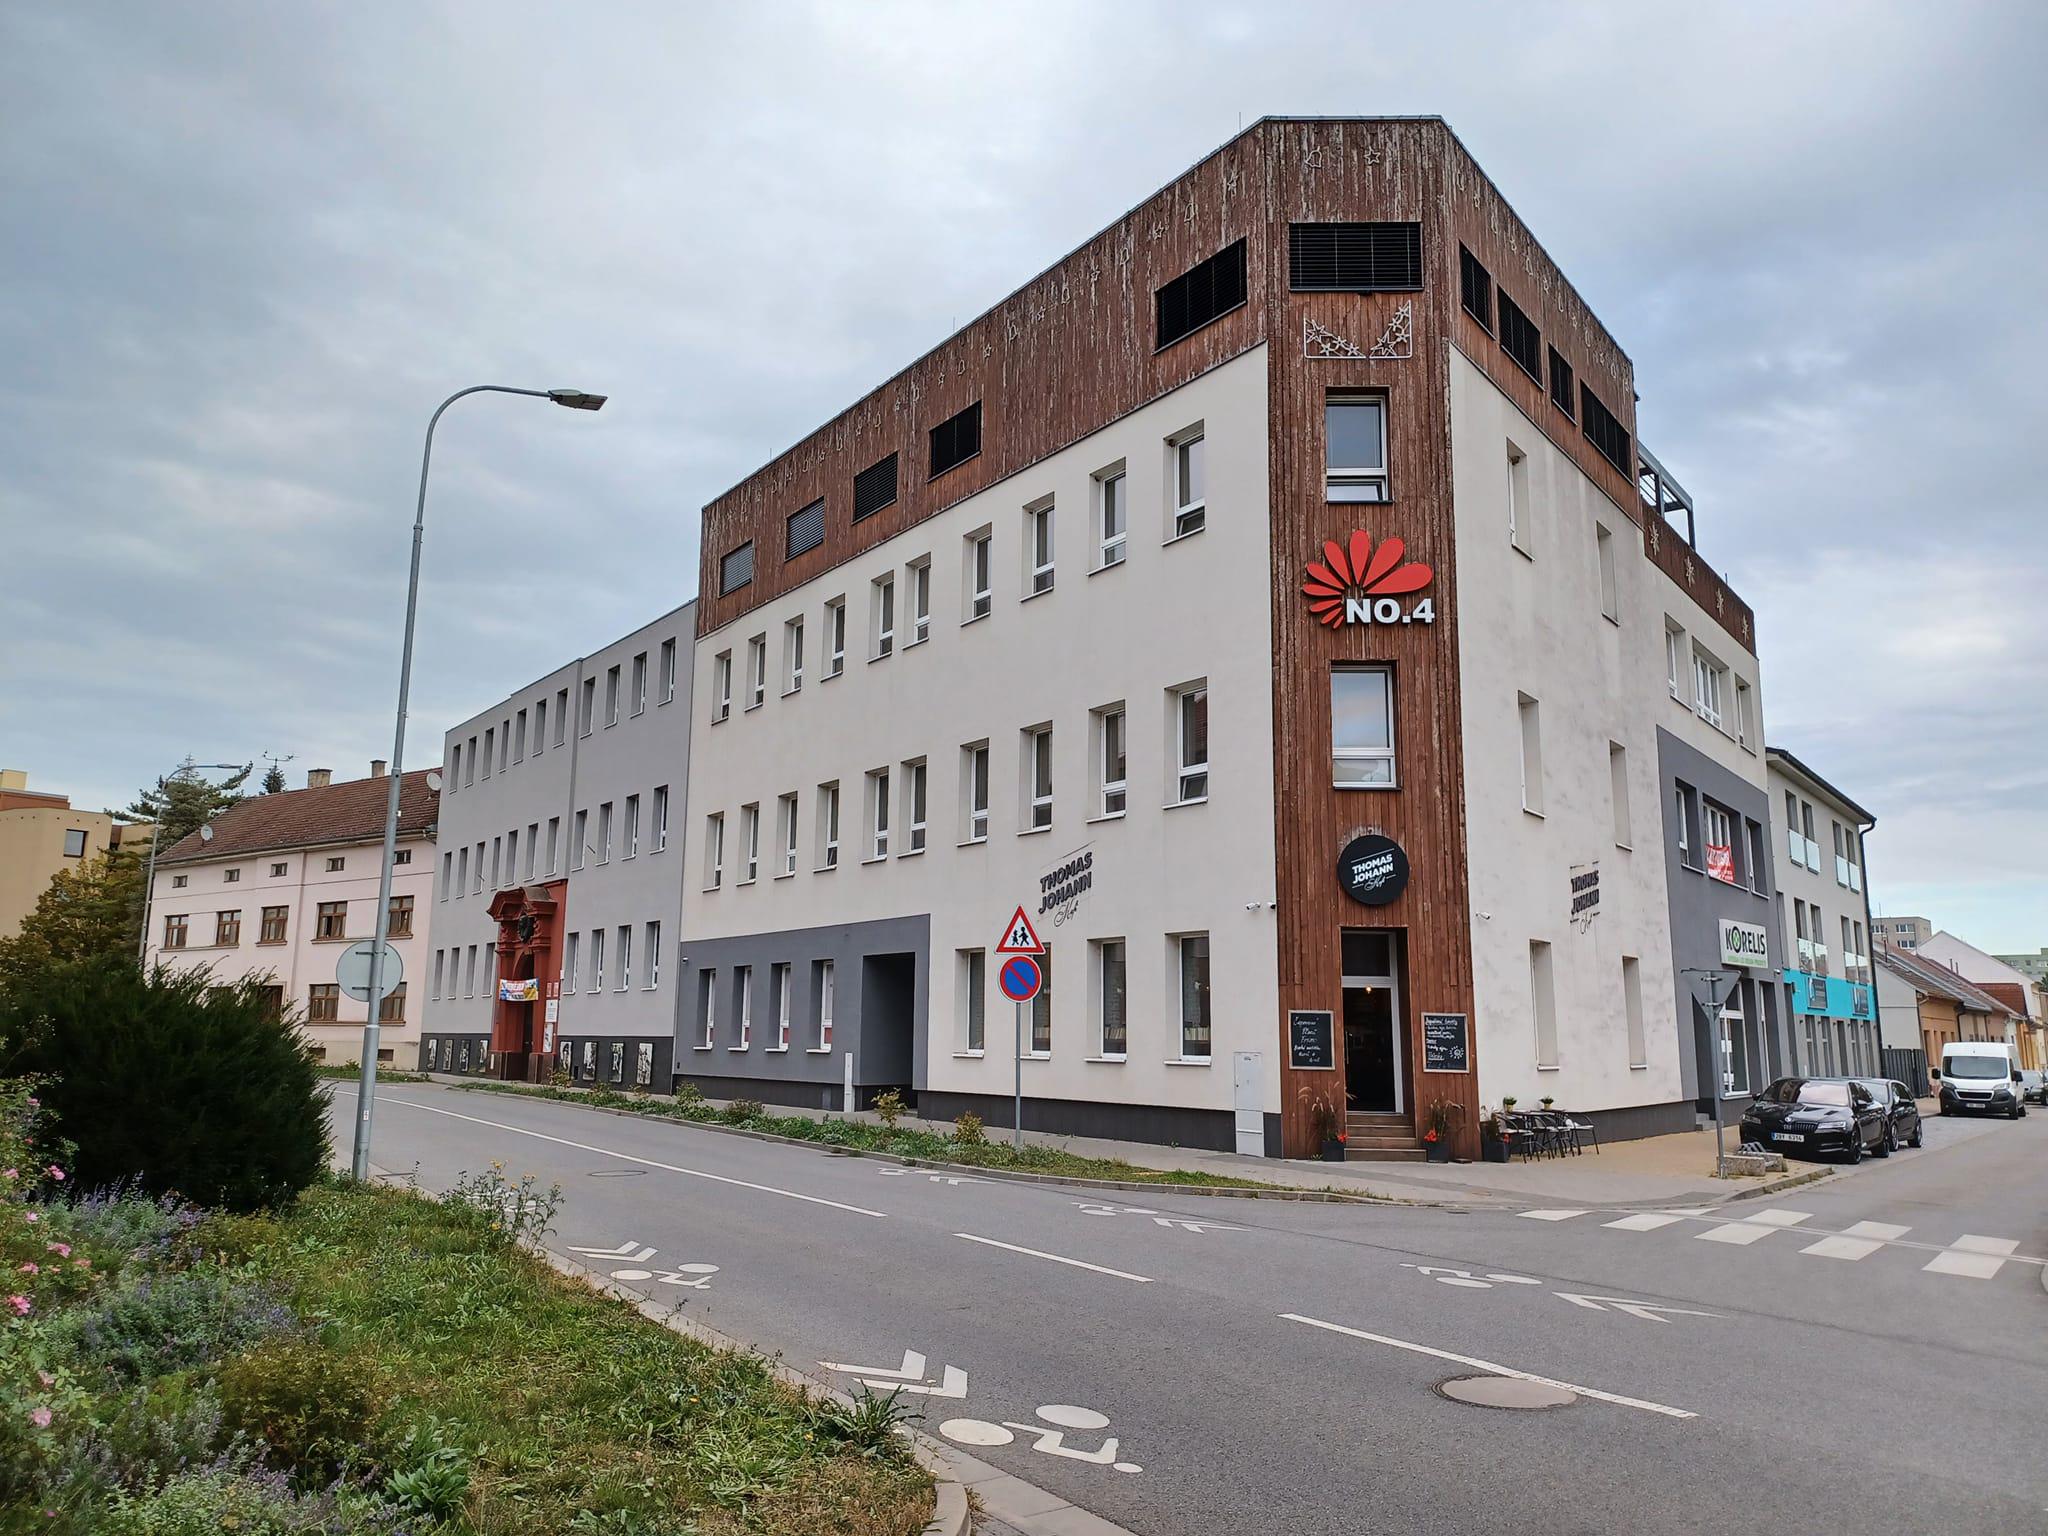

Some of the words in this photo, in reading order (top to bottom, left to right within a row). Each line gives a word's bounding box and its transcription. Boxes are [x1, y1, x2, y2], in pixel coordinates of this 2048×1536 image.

[1346, 598, 1435, 623] NO.4
[1040, 852, 1092, 893] THOMAS
[1352, 854, 1393, 874] THOMAS
[1353, 863, 1394, 884] JOHANN
[1038, 871, 1092, 915] JOHANN
[1725, 926, 1766, 955] KORELIS
